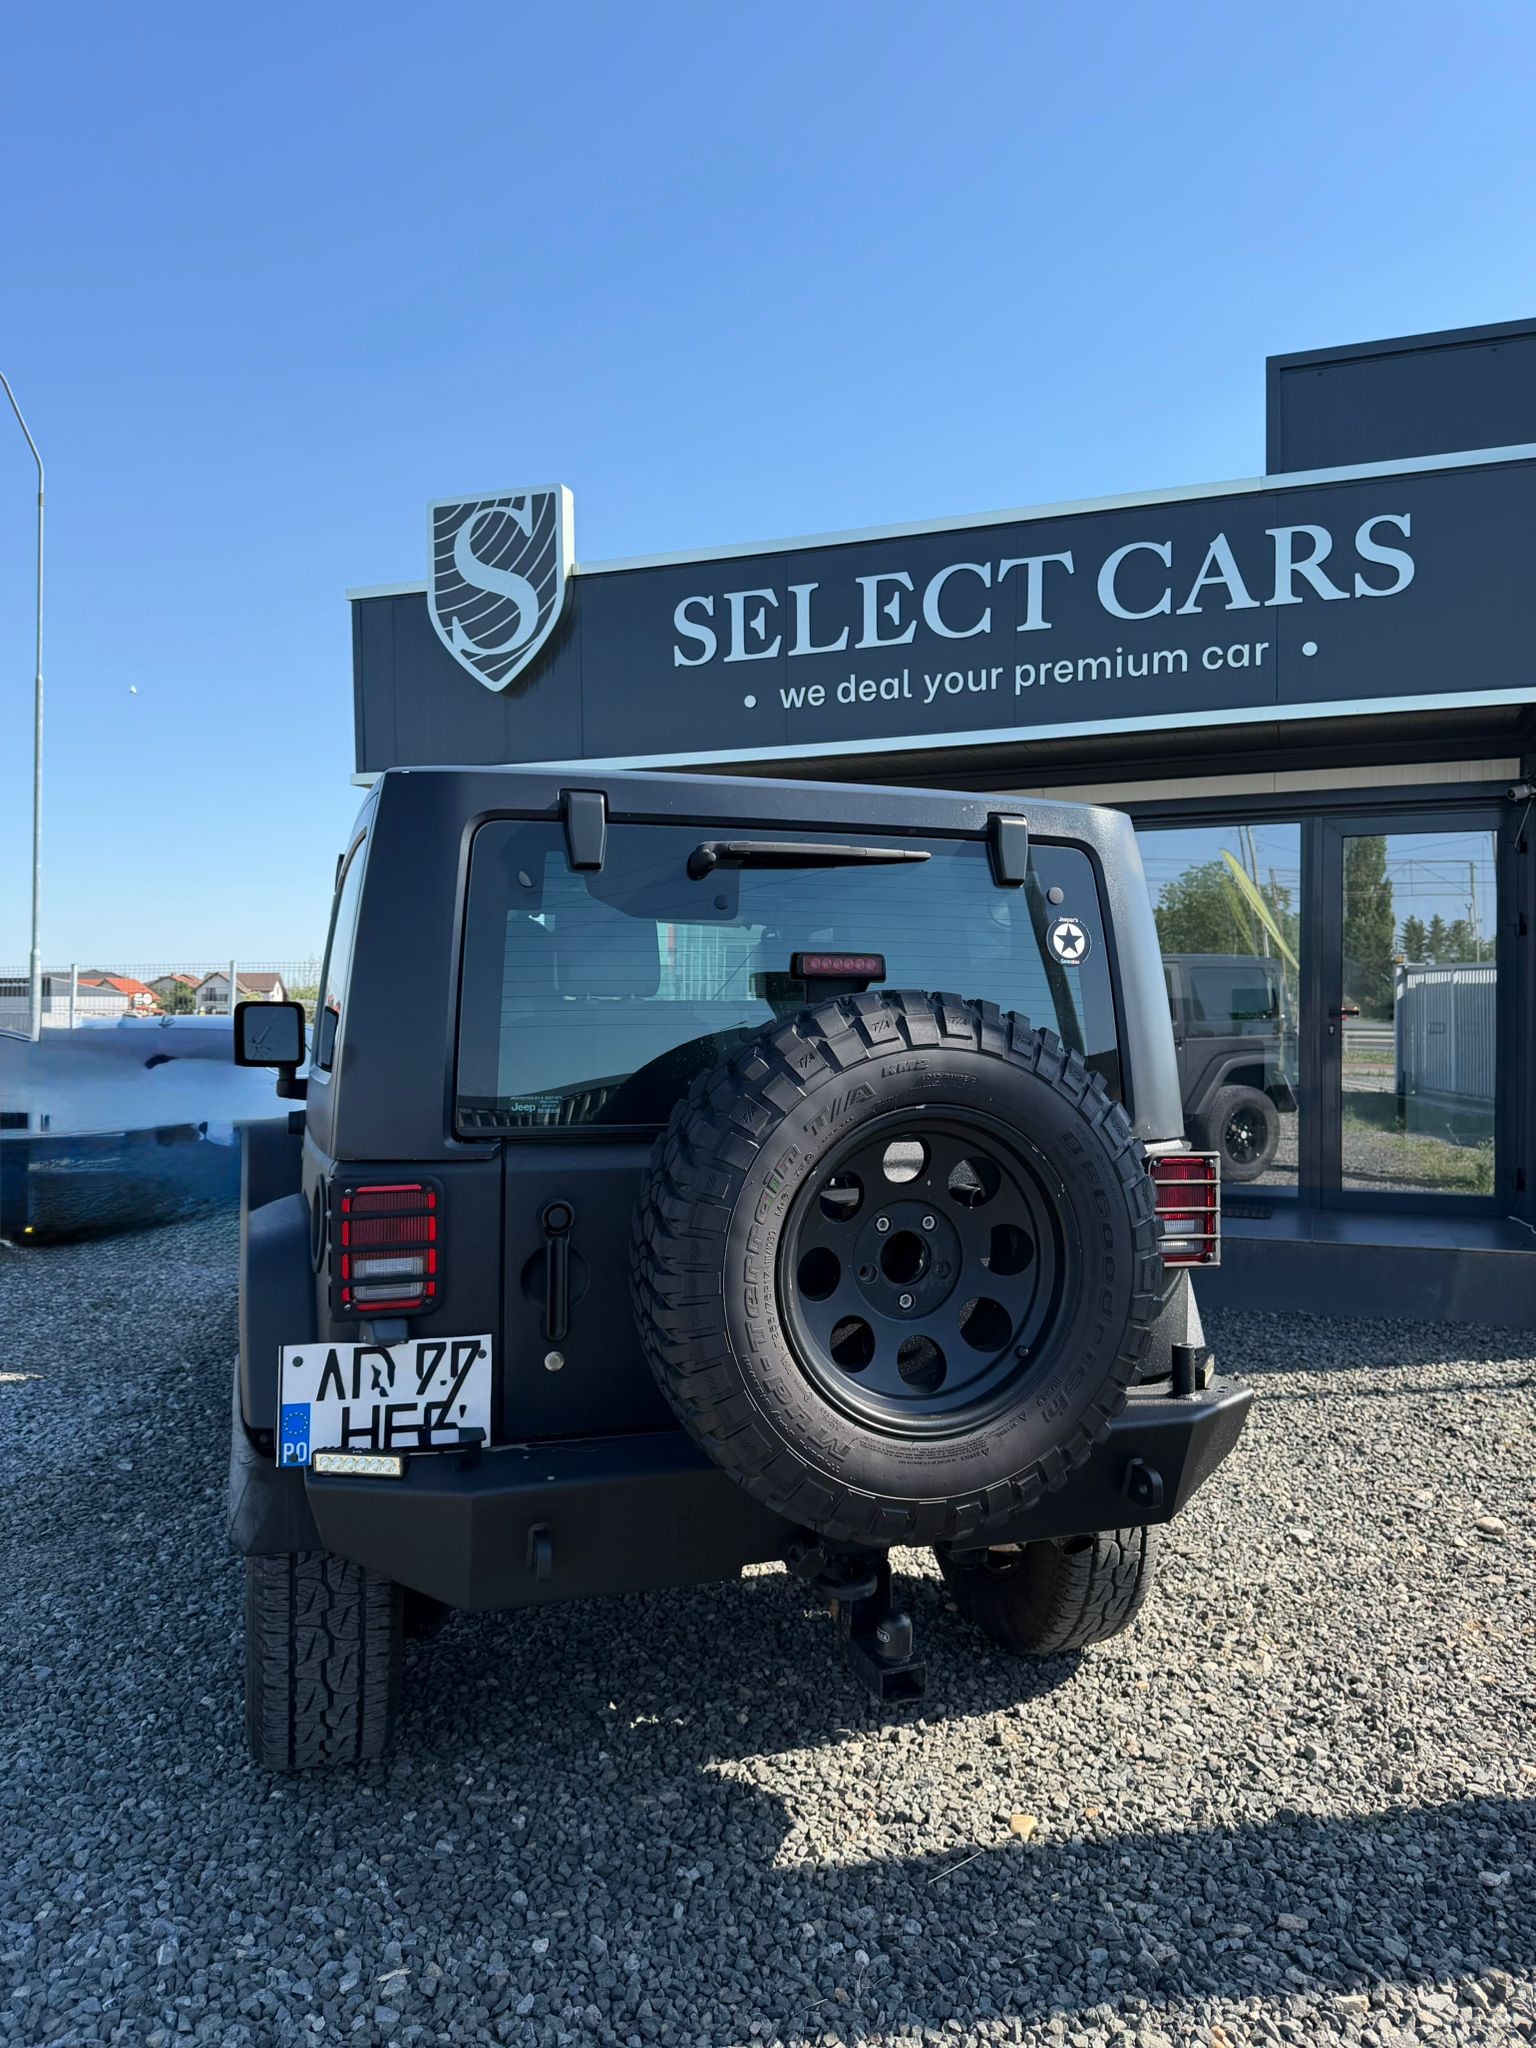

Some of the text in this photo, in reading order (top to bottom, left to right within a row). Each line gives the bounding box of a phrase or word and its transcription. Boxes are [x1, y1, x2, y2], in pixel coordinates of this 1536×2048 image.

[673, 513, 1416, 667] SELECT CARS
[780, 643, 1269, 708] we deal your premium car
[871, 1021, 890, 1034] T/A
[797, 1051, 816, 1070] T/A
[879, 1058, 928, 1078] KM2
[511, 1102, 536, 1113] Jeep
[1042, 1129, 1115, 1424] BFGoodrich
